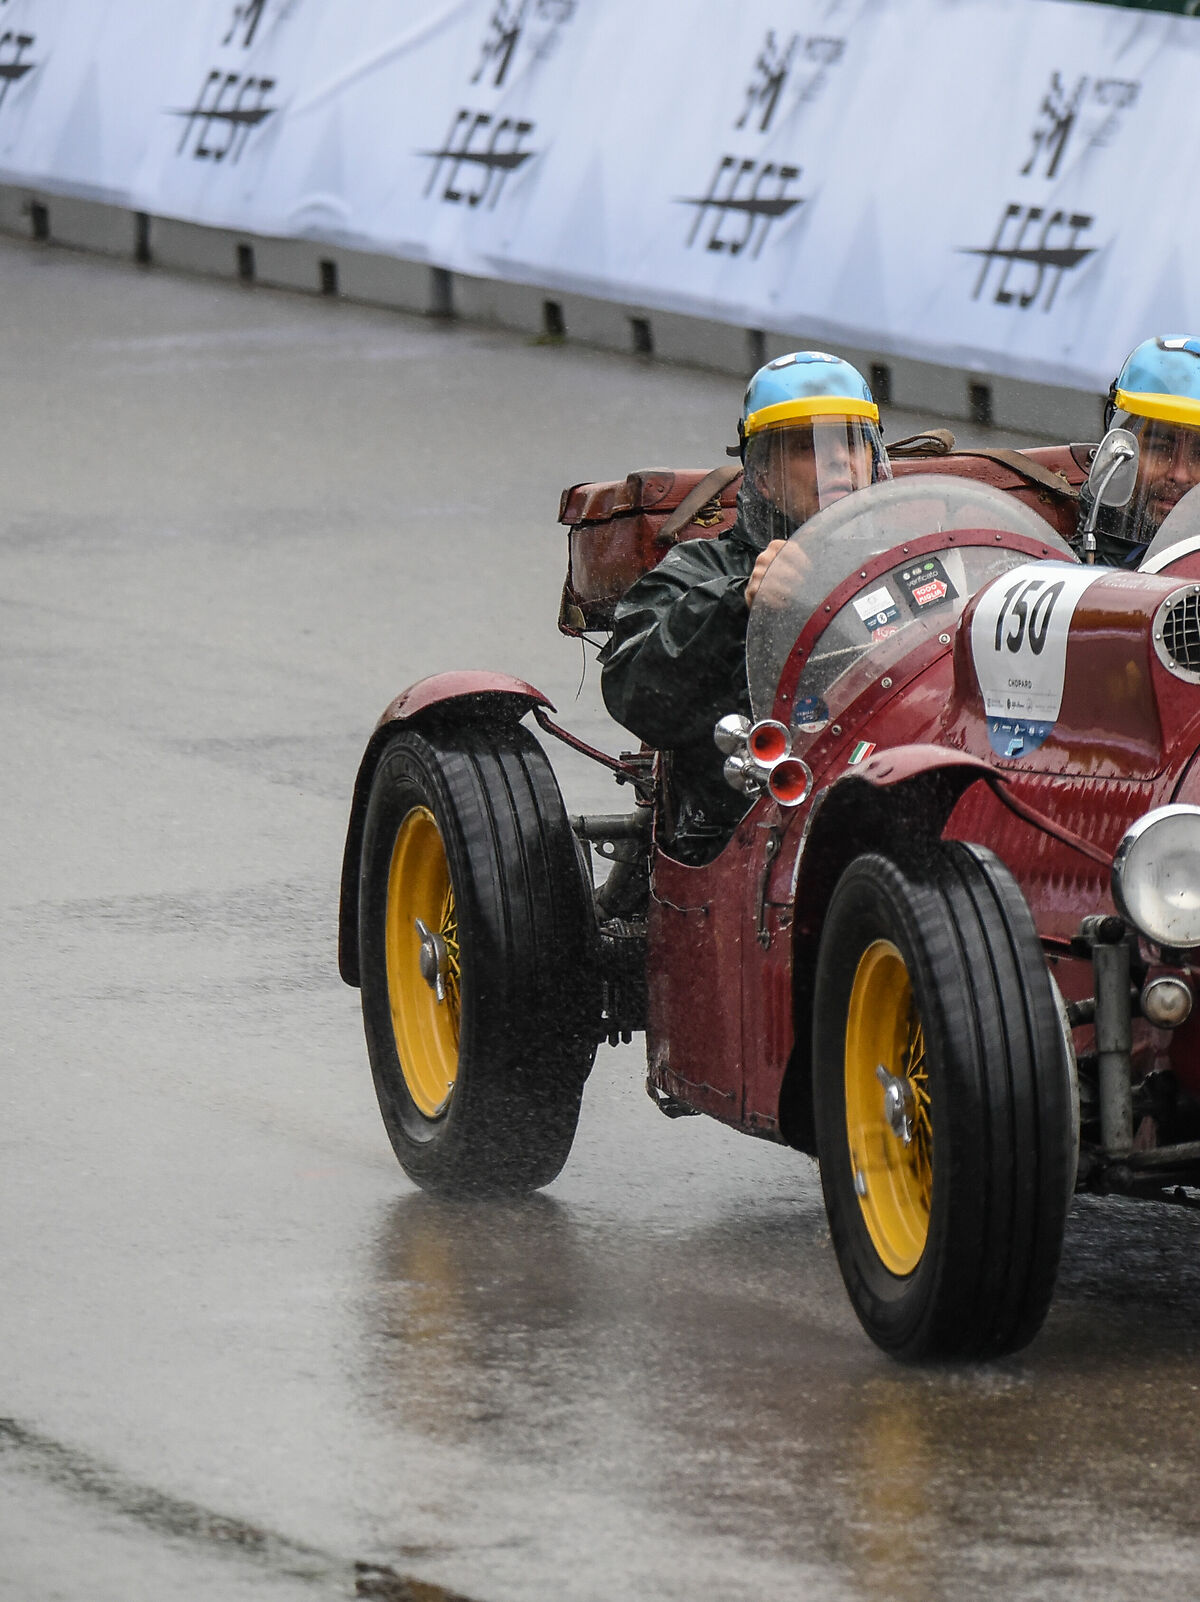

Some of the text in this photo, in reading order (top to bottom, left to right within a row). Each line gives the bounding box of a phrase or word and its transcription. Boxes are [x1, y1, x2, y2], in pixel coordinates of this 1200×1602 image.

[916, 584, 937, 597] 1000
[919, 589, 943, 603] MIGLIA
[994, 578, 1067, 656] 150
[1008, 678, 1033, 690] CHOPARD
